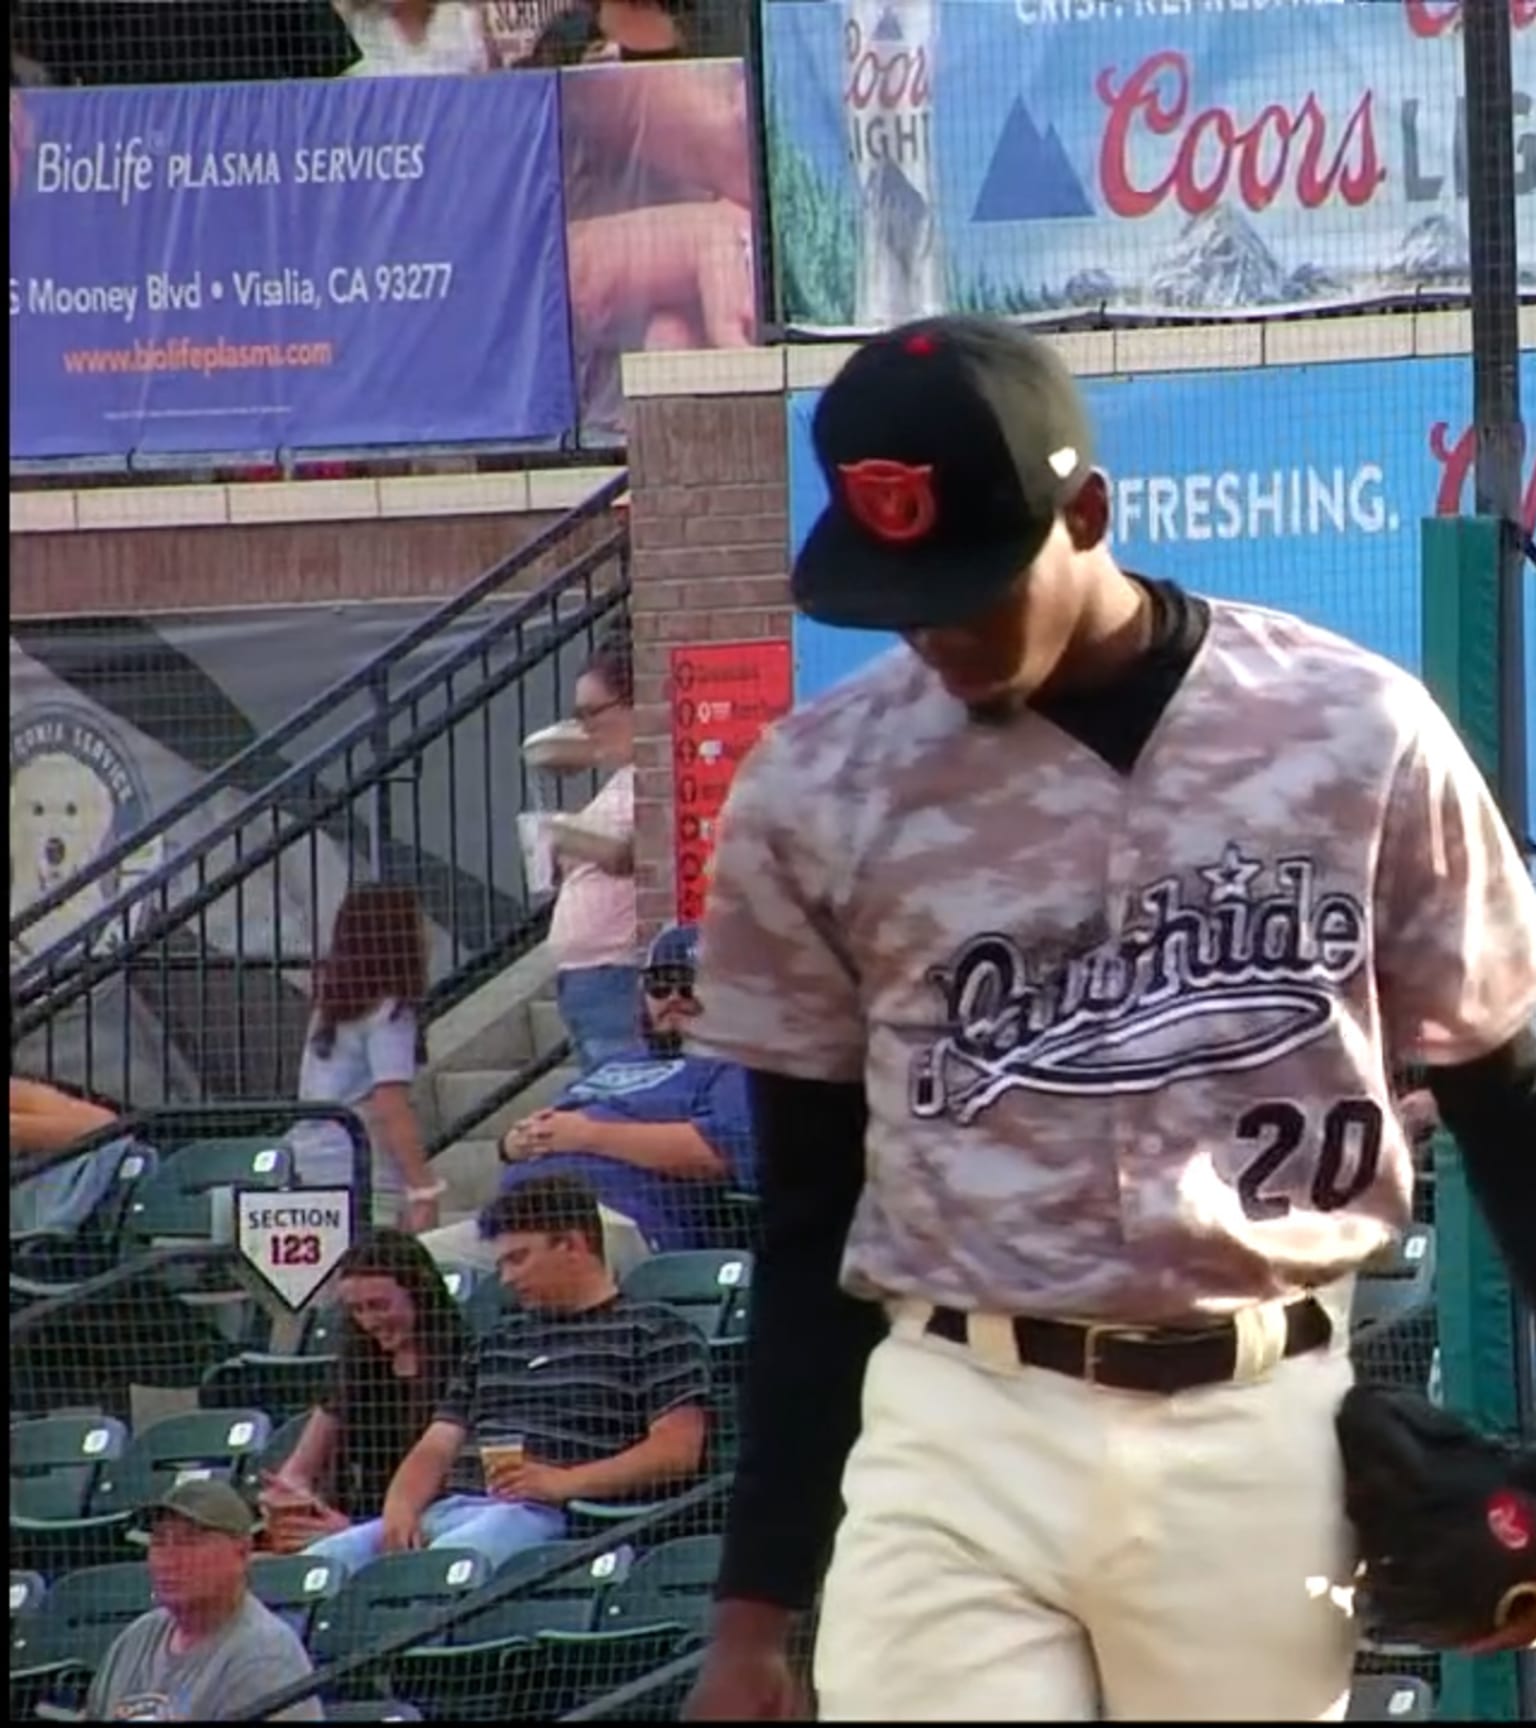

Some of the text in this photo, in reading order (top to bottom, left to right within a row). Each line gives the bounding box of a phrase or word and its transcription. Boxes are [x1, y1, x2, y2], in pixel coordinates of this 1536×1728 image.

[1096, 50, 1387, 218] Coors
[38, 137, 425, 204] BioLife PLASMA SERVICES
[28, 278, 138, 322] Mooney
[147, 271, 202, 311] Blvd
[233, 268, 322, 310] Visalia,
[328, 267, 370, 304] CA
[375, 262, 453, 300] 93277
[1235, 1100, 1384, 1221] 20
[249, 1207, 341, 1230] SECTION
[270, 1234, 322, 1265] 123
